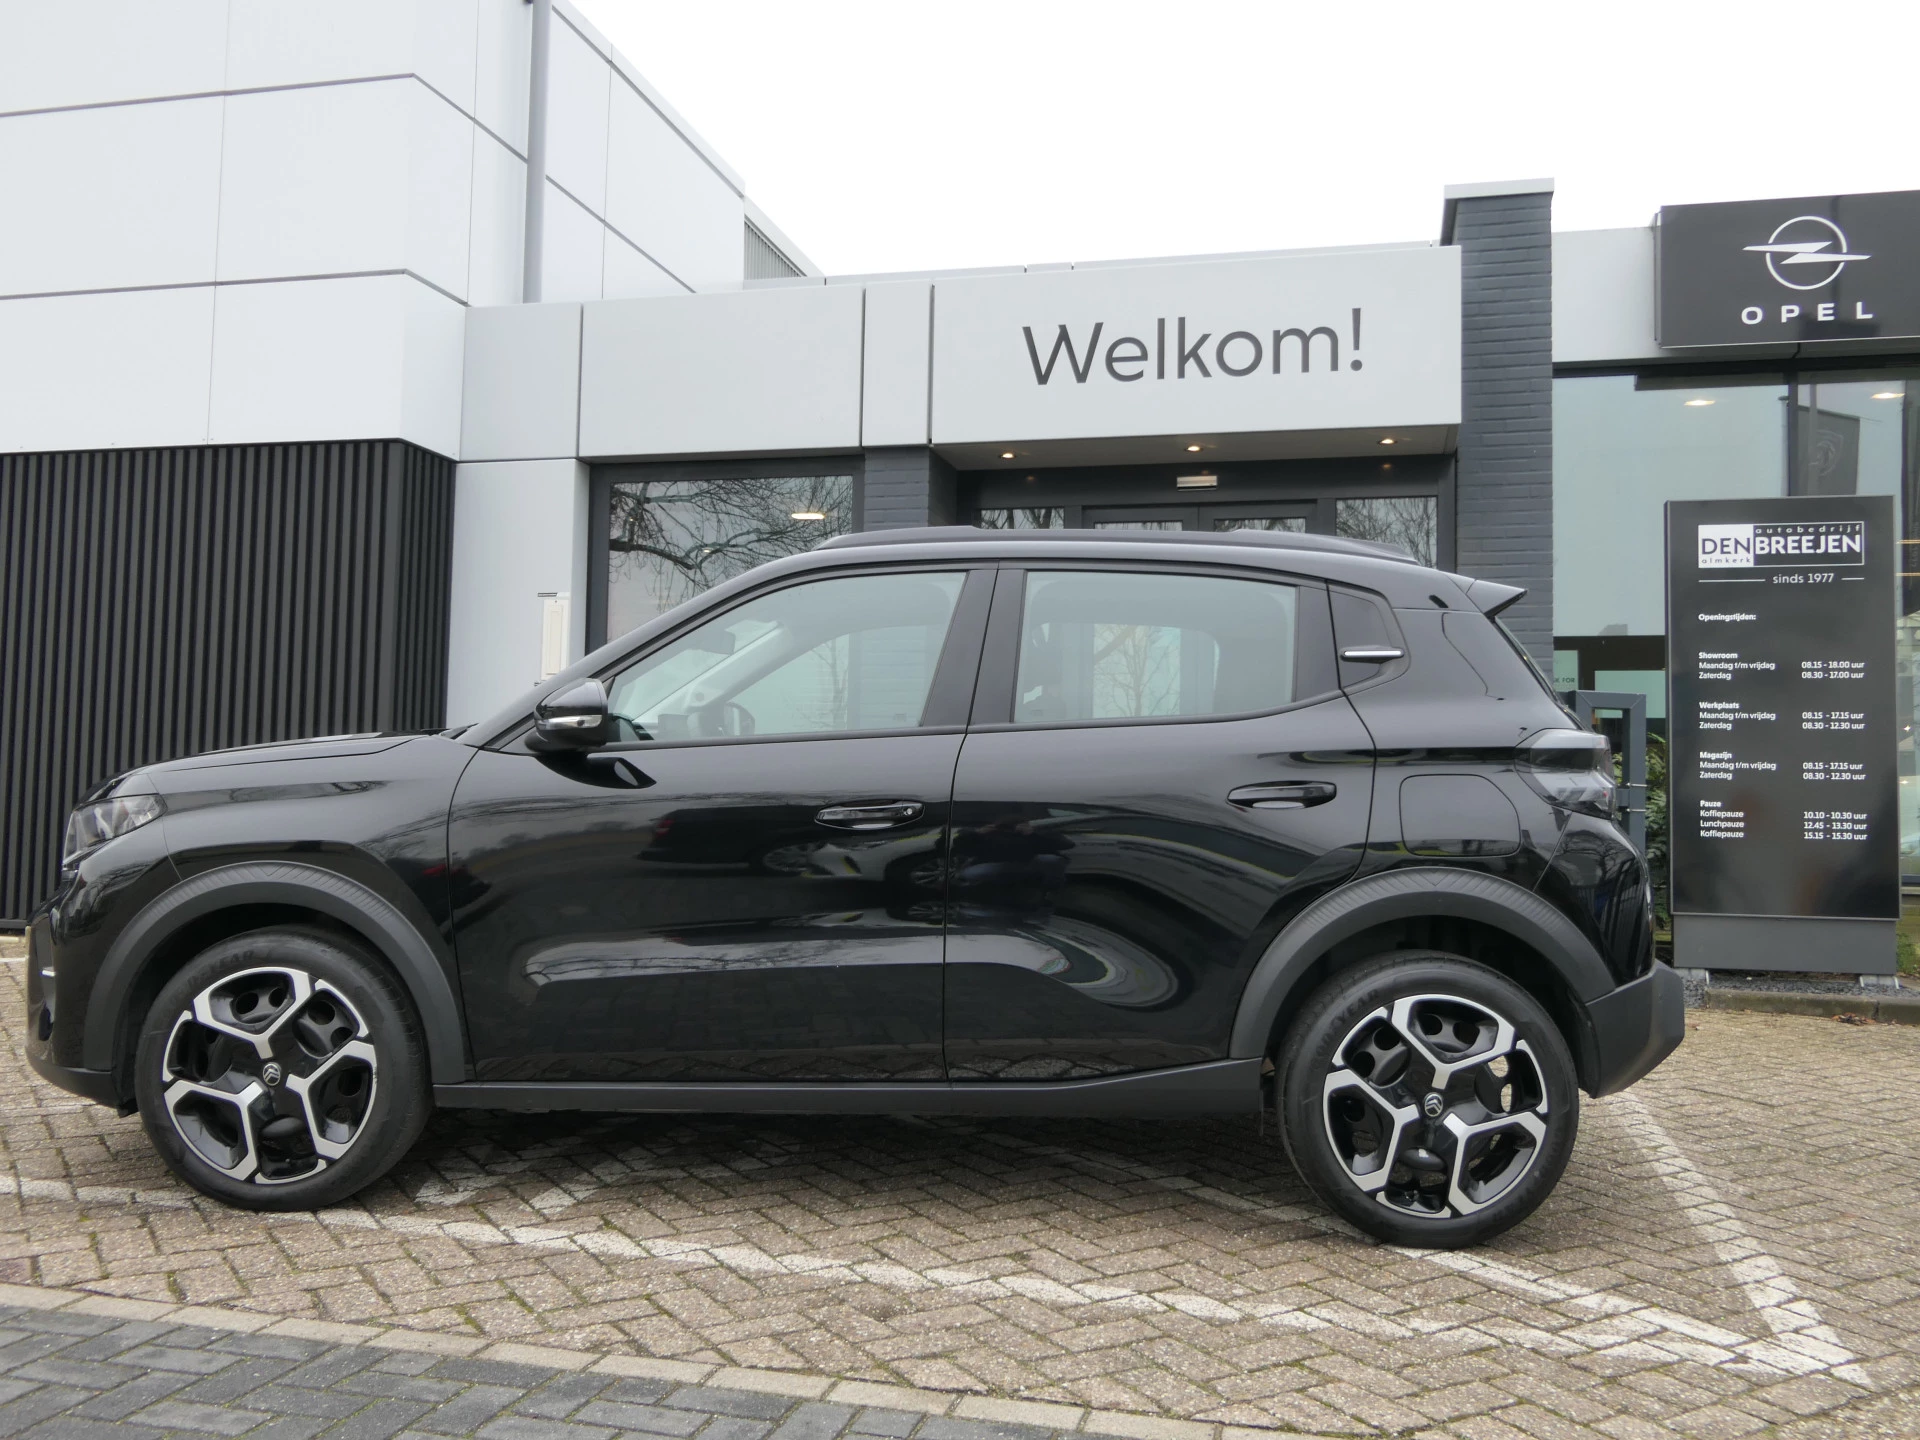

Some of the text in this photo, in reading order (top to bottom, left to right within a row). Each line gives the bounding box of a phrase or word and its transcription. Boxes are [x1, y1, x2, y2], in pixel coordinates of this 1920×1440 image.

[1742, 302, 1873, 324] OPEL
[1023, 308, 1362, 385] Welkom!
[1755, 525, 1860, 534] autobedrijf
[1701, 534, 1861, 555] DEN BREEJEN
[1773, 573, 1834, 583] sinds 1977
[1698, 613, 1756, 622] Openingstijden:
[1699, 662, 1733, 670] Maandag
[1749, 662, 1775, 670] vrijdag
[1699, 672, 1731, 680] Zaterdag
[1699, 702, 1740, 710] Werkplaats
[1700, 712, 1733, 720] Maandag
[1750, 712, 1776, 720] vrijdag
[1699, 722, 1732, 730] Zaterdag
[1700, 752, 1732, 760] Magazijn
[1700, 761, 1734, 770] Maandag
[1750, 762, 1776, 770] vrijdag
[1830, 762, 1848, 770] 17.15
[1700, 771, 1732, 780] Zaterdag
[1803, 772, 1825, 780] 08.30
[1700, 810, 1744, 818] Koffiepauze
[1700, 820, 1744, 828] Lunchpauze
[1701, 830, 1744, 838] Koffiepauze
[1832, 832, 1852, 840] 15.30
